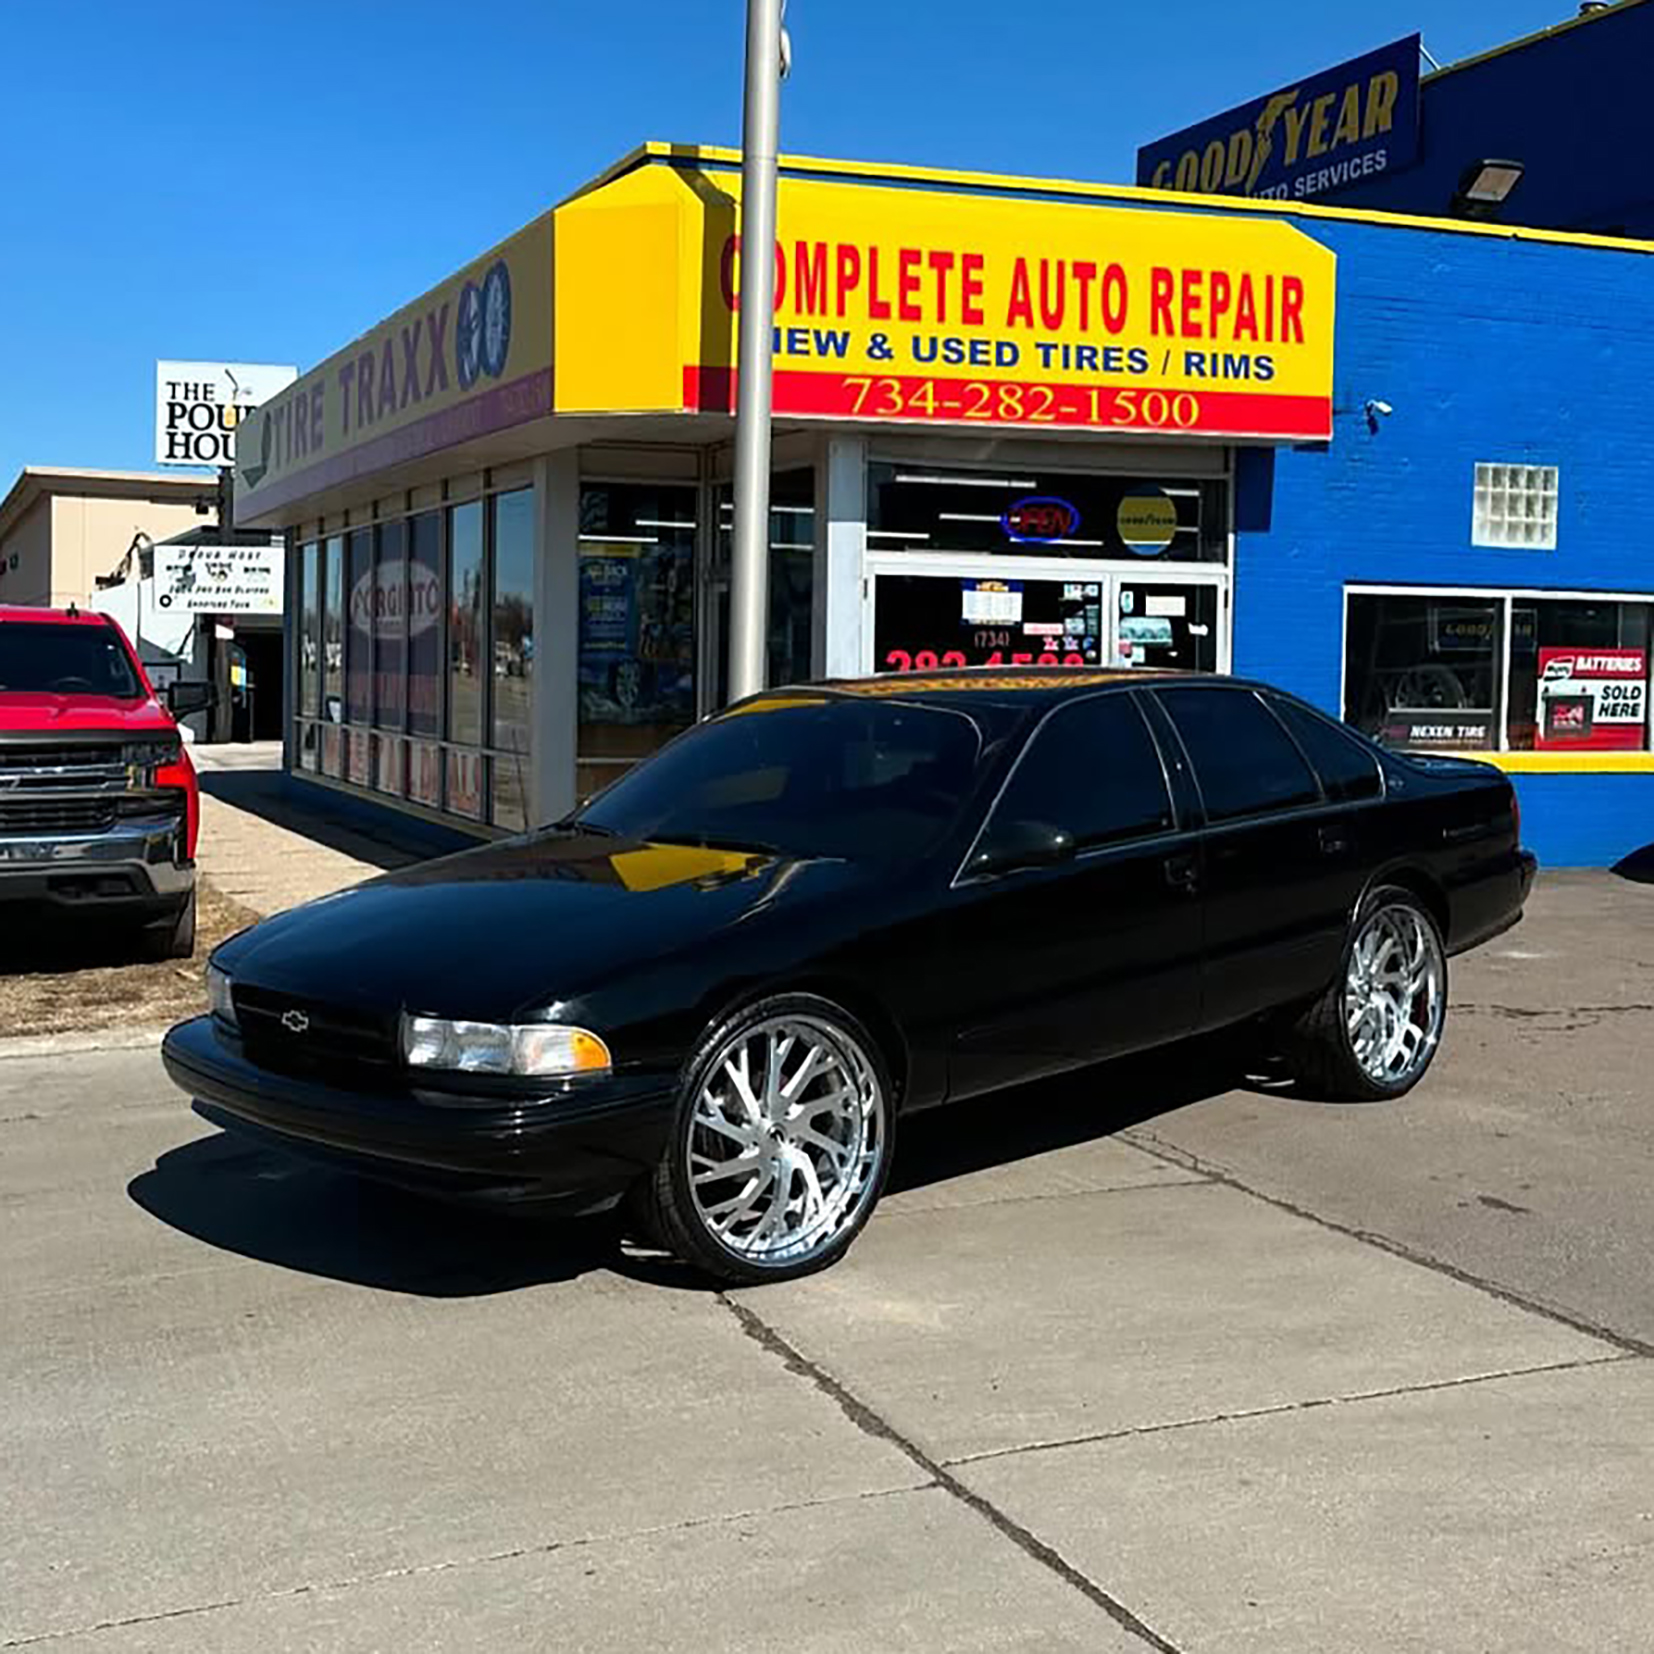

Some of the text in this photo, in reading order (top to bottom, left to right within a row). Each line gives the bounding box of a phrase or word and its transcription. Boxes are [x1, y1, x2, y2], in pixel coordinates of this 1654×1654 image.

[1152, 71, 1398, 192] GOODYEAR
[1293, 150, 1387, 198] SERVICES
[1006, 257, 1129, 335] AUTO
[1150, 266, 1305, 343] REPAIR
[866, 332, 895, 361] &
[912, 335, 1020, 368] USED
[1035, 341, 1149, 374] TIRES
[1183, 350, 1276, 381] RIMS
[165, 381, 216, 402] THE
[271, 380, 325, 467] TIRE
[339, 302, 449, 436] TRAXX
[842, 377, 1200, 427] 734-282-1500
[1576, 655, 1642, 672] BATTERIES
[1598, 703, 1641, 718] HERE
[1600, 685, 1642, 700] SOLD
[1410, 725, 1486, 737] NEXEN TIRE
